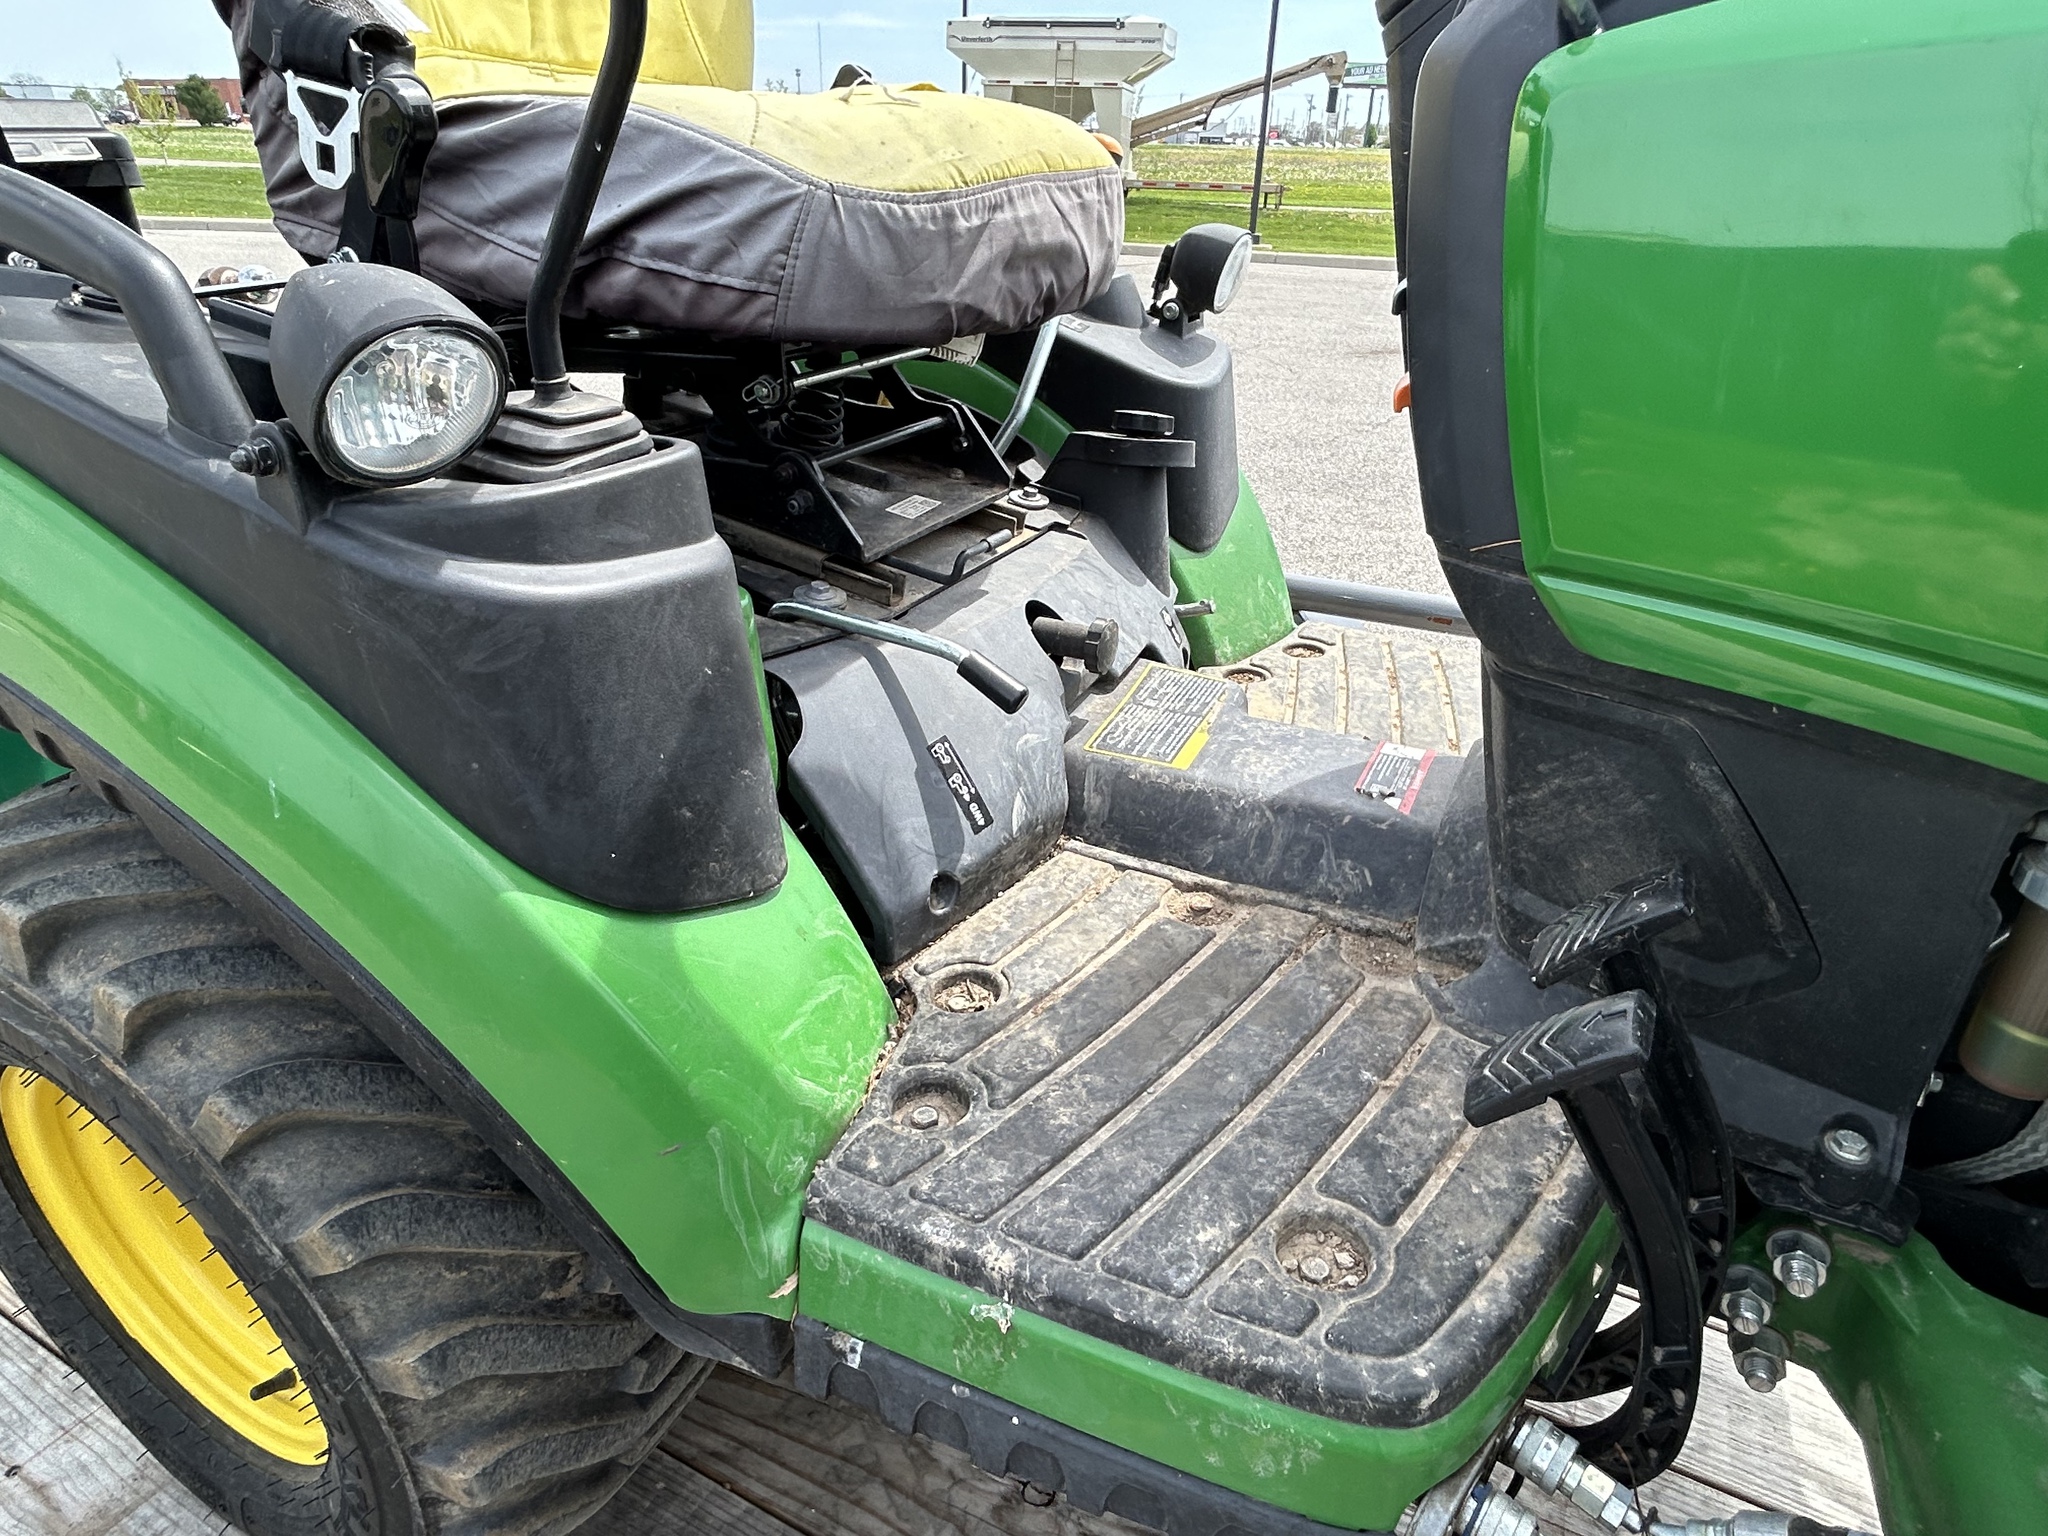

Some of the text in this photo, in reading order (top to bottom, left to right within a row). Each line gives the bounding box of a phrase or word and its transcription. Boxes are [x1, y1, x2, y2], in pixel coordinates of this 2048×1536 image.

[1351, 64, 1387, 76] YOUR AD HER
[969, 802, 985, 826] 4WD
